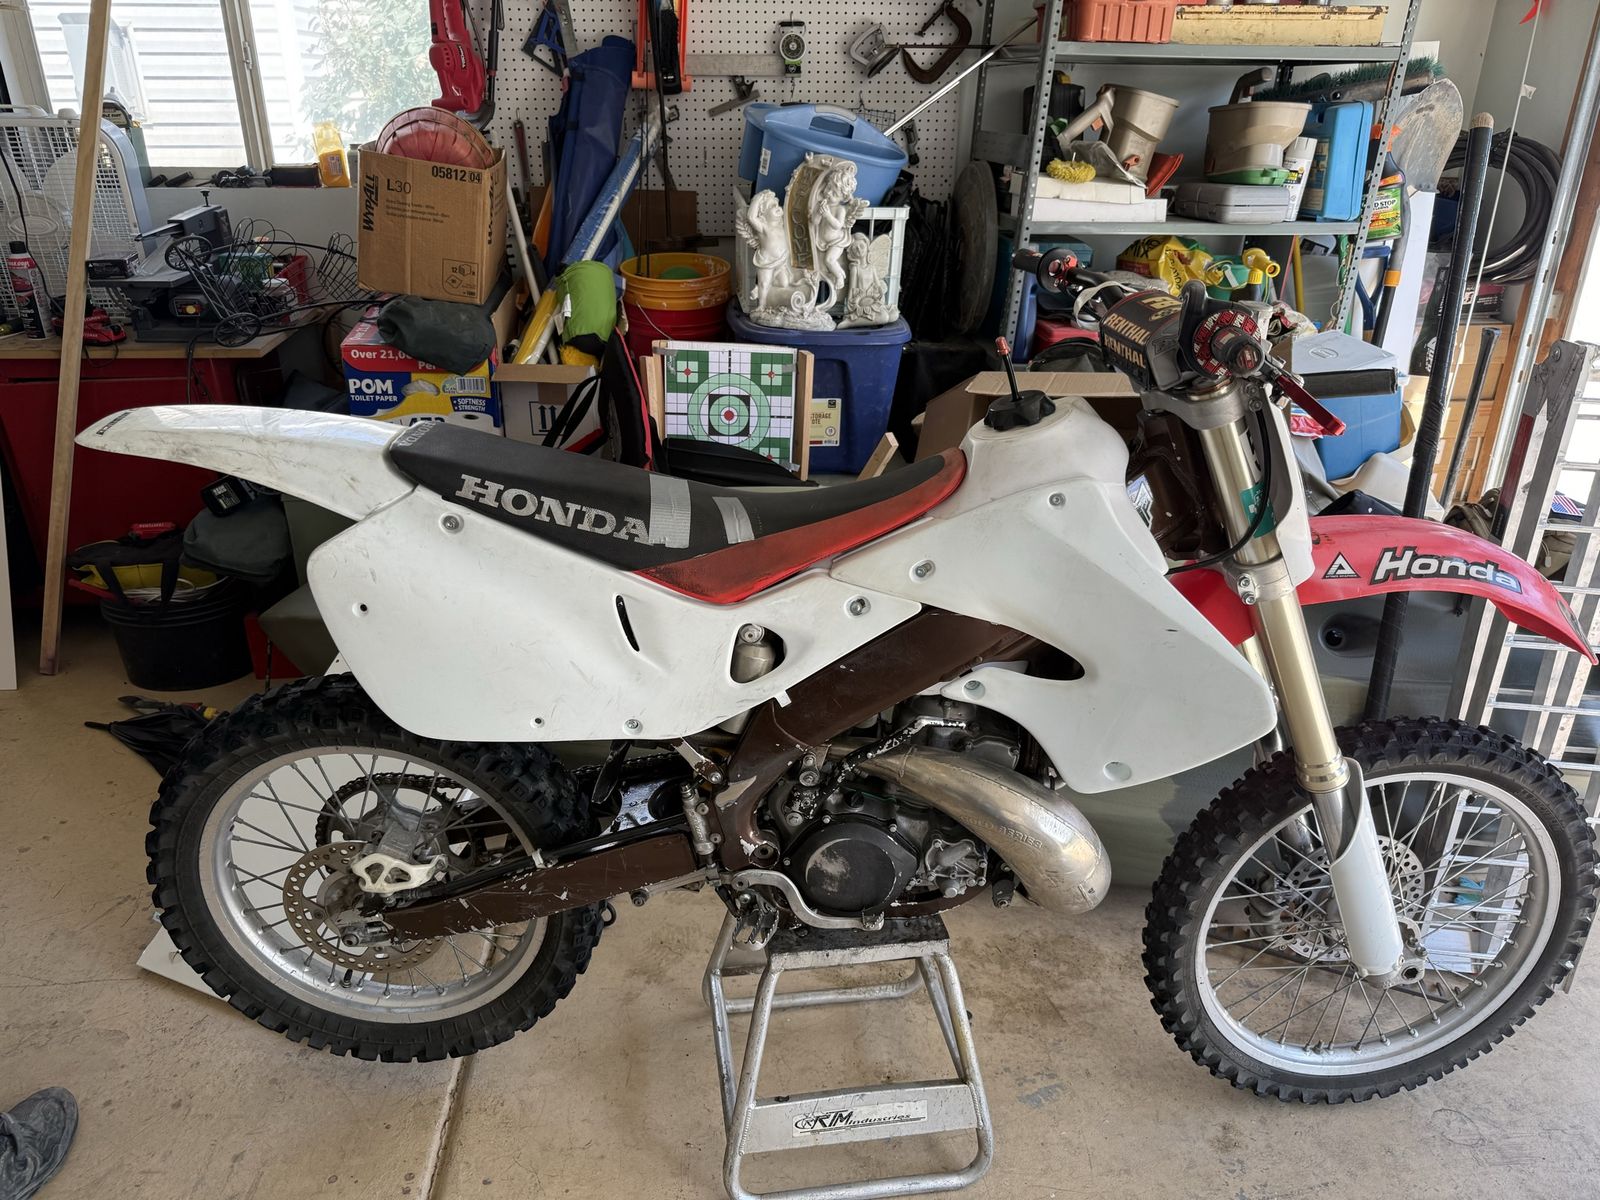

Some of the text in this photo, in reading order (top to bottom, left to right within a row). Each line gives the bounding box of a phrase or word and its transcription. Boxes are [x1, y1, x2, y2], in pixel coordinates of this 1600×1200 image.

[432, 165, 481, 183] 05812 04
[386, 178, 412, 194] L30
[1103, 312, 1151, 345] RENTHAL
[350, 349, 378, 359] Over
[1104, 332, 1147, 369] RENTHAL
[349, 378, 393, 395] POM
[457, 398, 486, 406] SOFTNESS
[455, 474, 654, 546] HONDA
[1373, 548, 1519, 591] Honda
